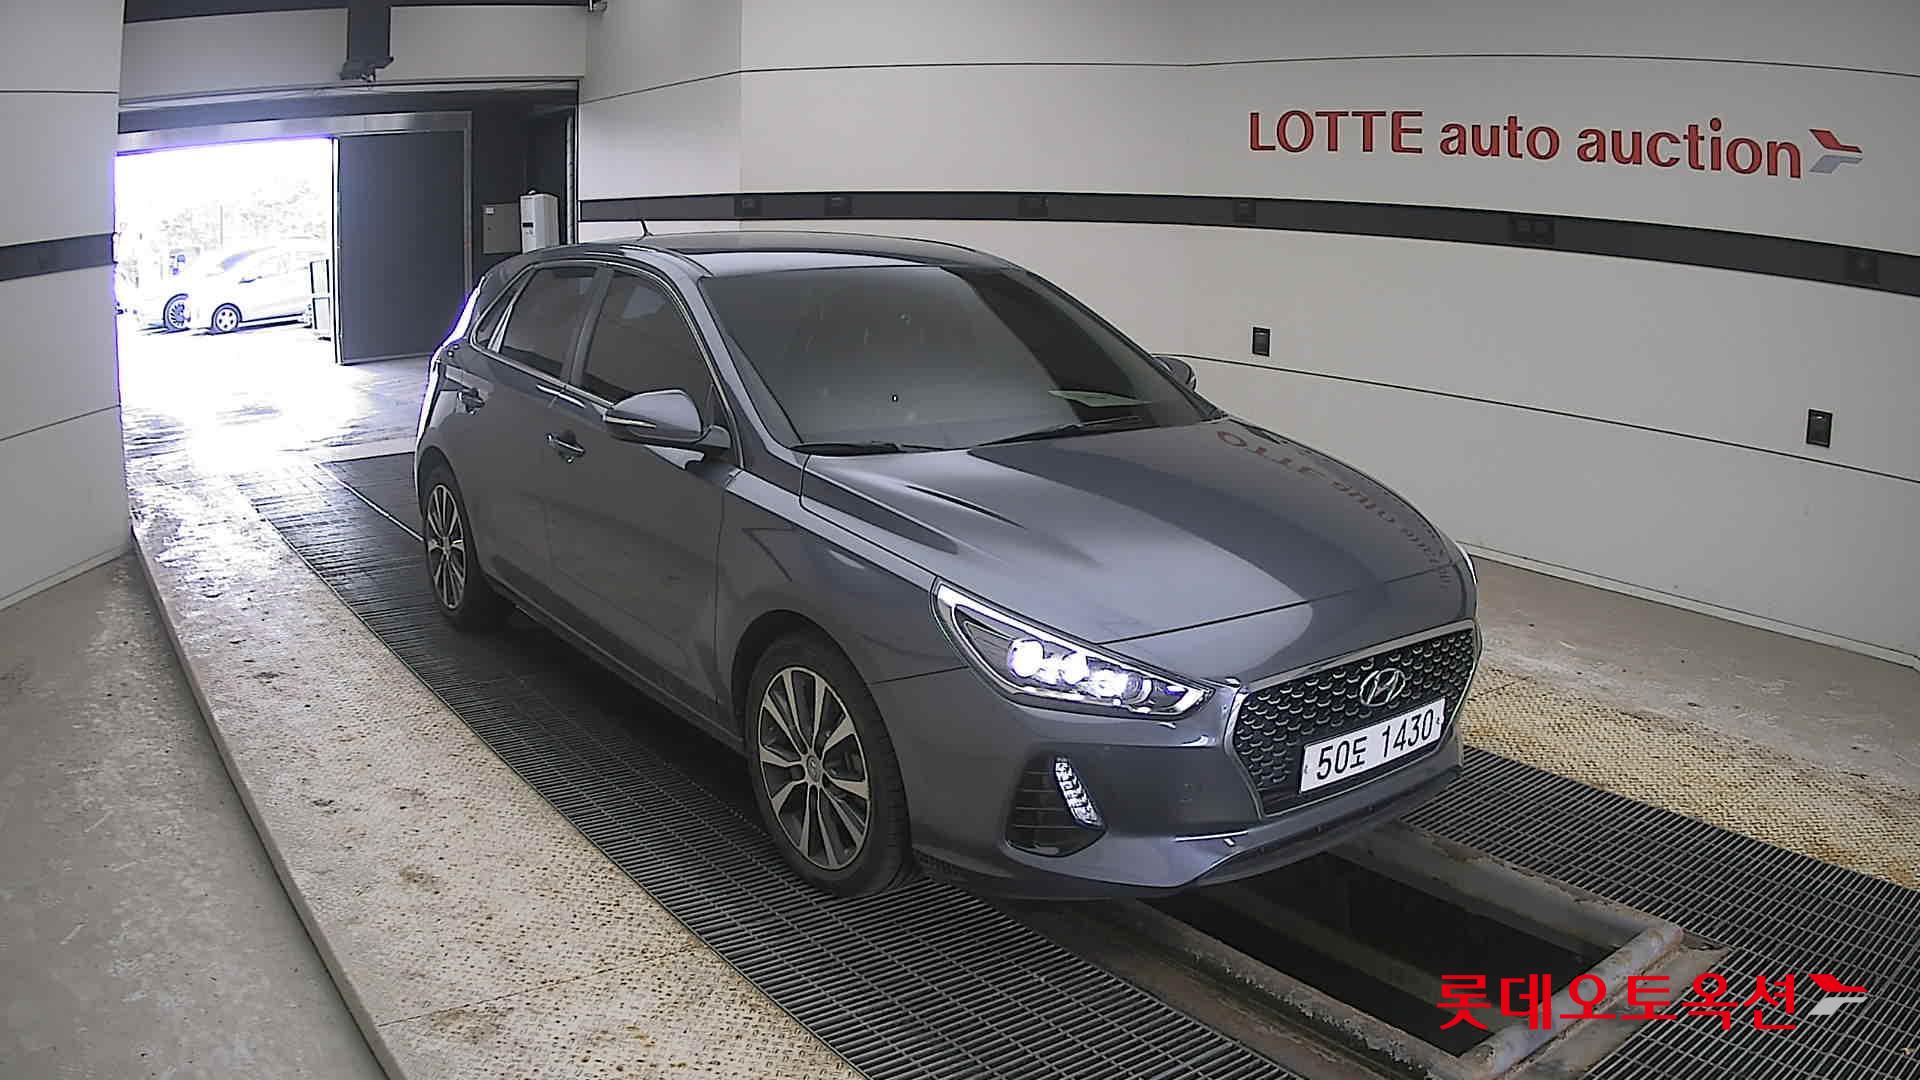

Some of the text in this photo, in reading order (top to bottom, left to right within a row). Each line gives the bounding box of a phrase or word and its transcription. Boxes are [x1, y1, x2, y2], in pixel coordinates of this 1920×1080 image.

[1248, 110, 1803, 179] LOTTE auto auction
[1315, 708, 1434, 781] 50도 1430
